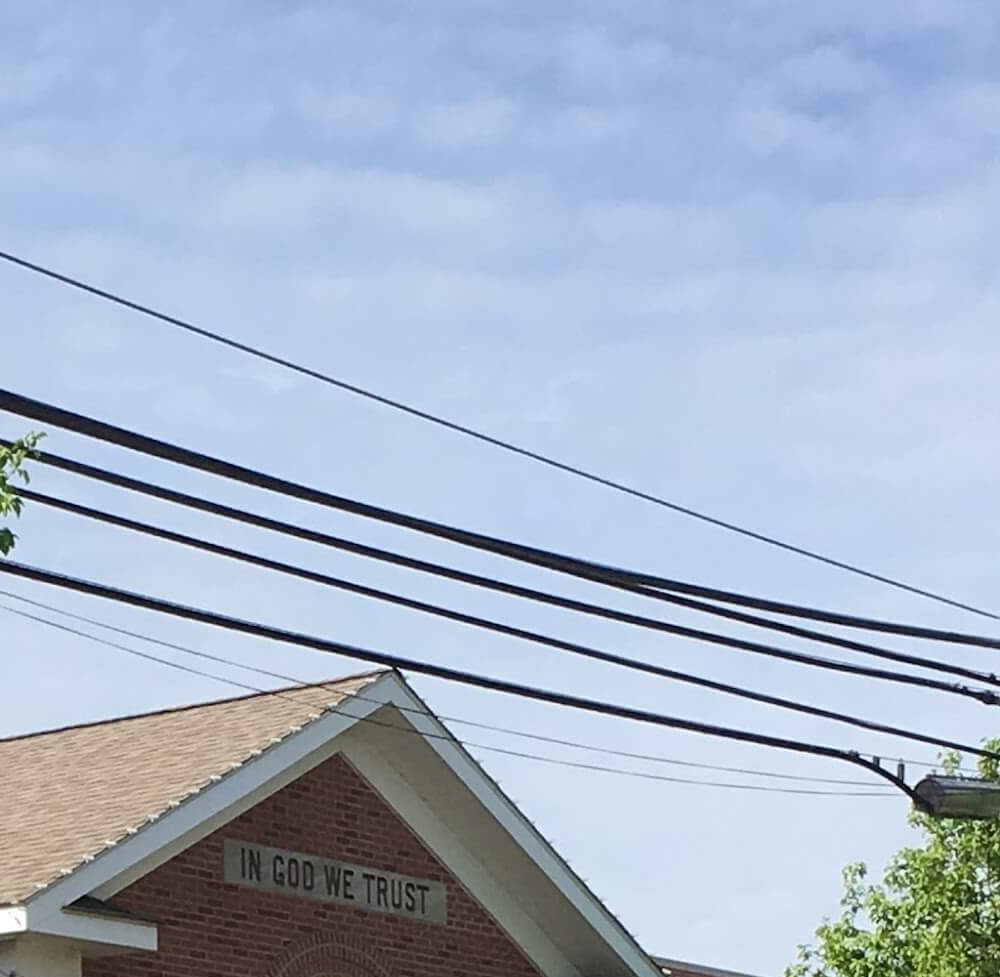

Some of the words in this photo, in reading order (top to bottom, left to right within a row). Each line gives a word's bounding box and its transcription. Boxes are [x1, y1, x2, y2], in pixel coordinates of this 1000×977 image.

[240, 847, 261, 882] IN
[272, 854, 314, 891] GOD
[323, 864, 354, 899] WE
[362, 872, 430, 914] TRUST
